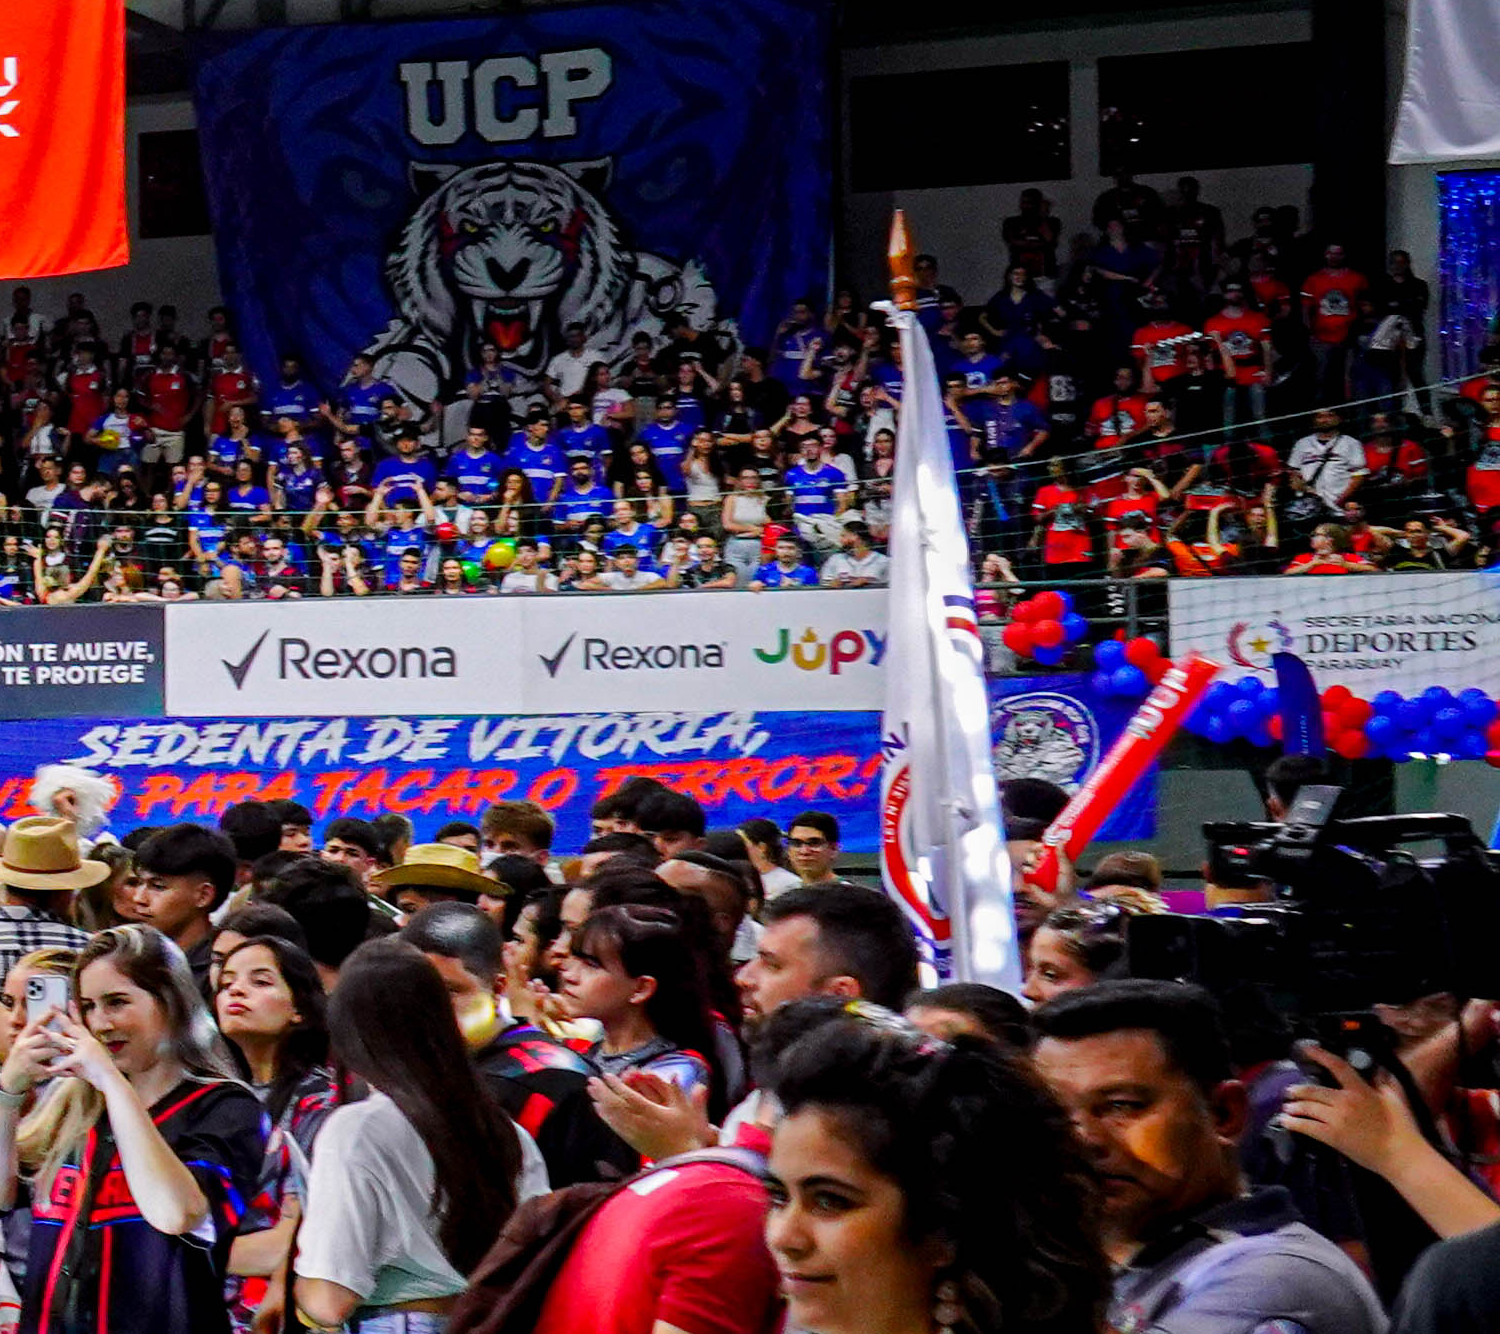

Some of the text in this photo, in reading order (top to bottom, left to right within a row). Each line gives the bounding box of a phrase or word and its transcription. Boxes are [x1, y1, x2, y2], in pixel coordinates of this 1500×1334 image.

[399, 48, 612, 144] UCP
[1304, 615, 1414, 628] SECRETARIA
[28, 644, 59, 664] TE
[62, 642, 156, 665] MUEVE,
[278, 638, 458, 680] Rexona
[583, 637, 726, 670] Rexona
[1305, 630, 1478, 655] DEPORTES
[1, 666, 30, 685] TE
[35, 664, 147, 685] PROTEGE
[61, 710, 770, 770] SEDENTA DE VITORIA,
[132, 770, 299, 817] PARA
[313, 766, 519, 817] TACAR
[526, 767, 581, 811] O
